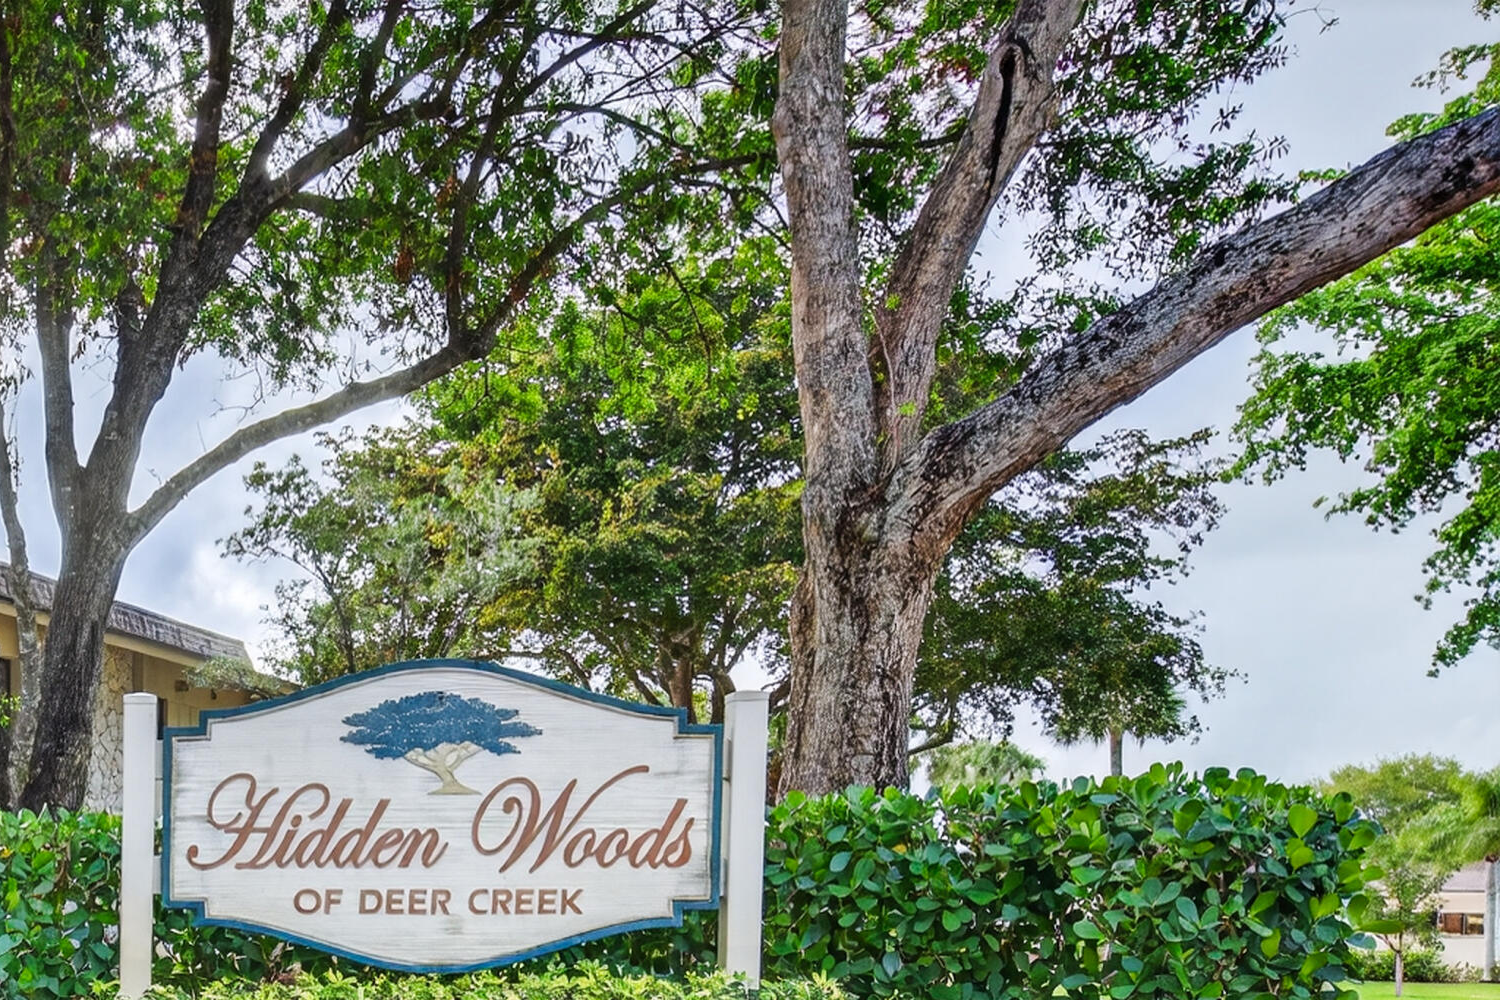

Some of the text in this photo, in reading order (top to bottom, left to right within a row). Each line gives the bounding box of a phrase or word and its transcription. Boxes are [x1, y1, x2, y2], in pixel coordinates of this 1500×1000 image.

[186, 765, 696, 874] Hidden Woods
[293, 888, 585, 915] OF DEER CREEK
